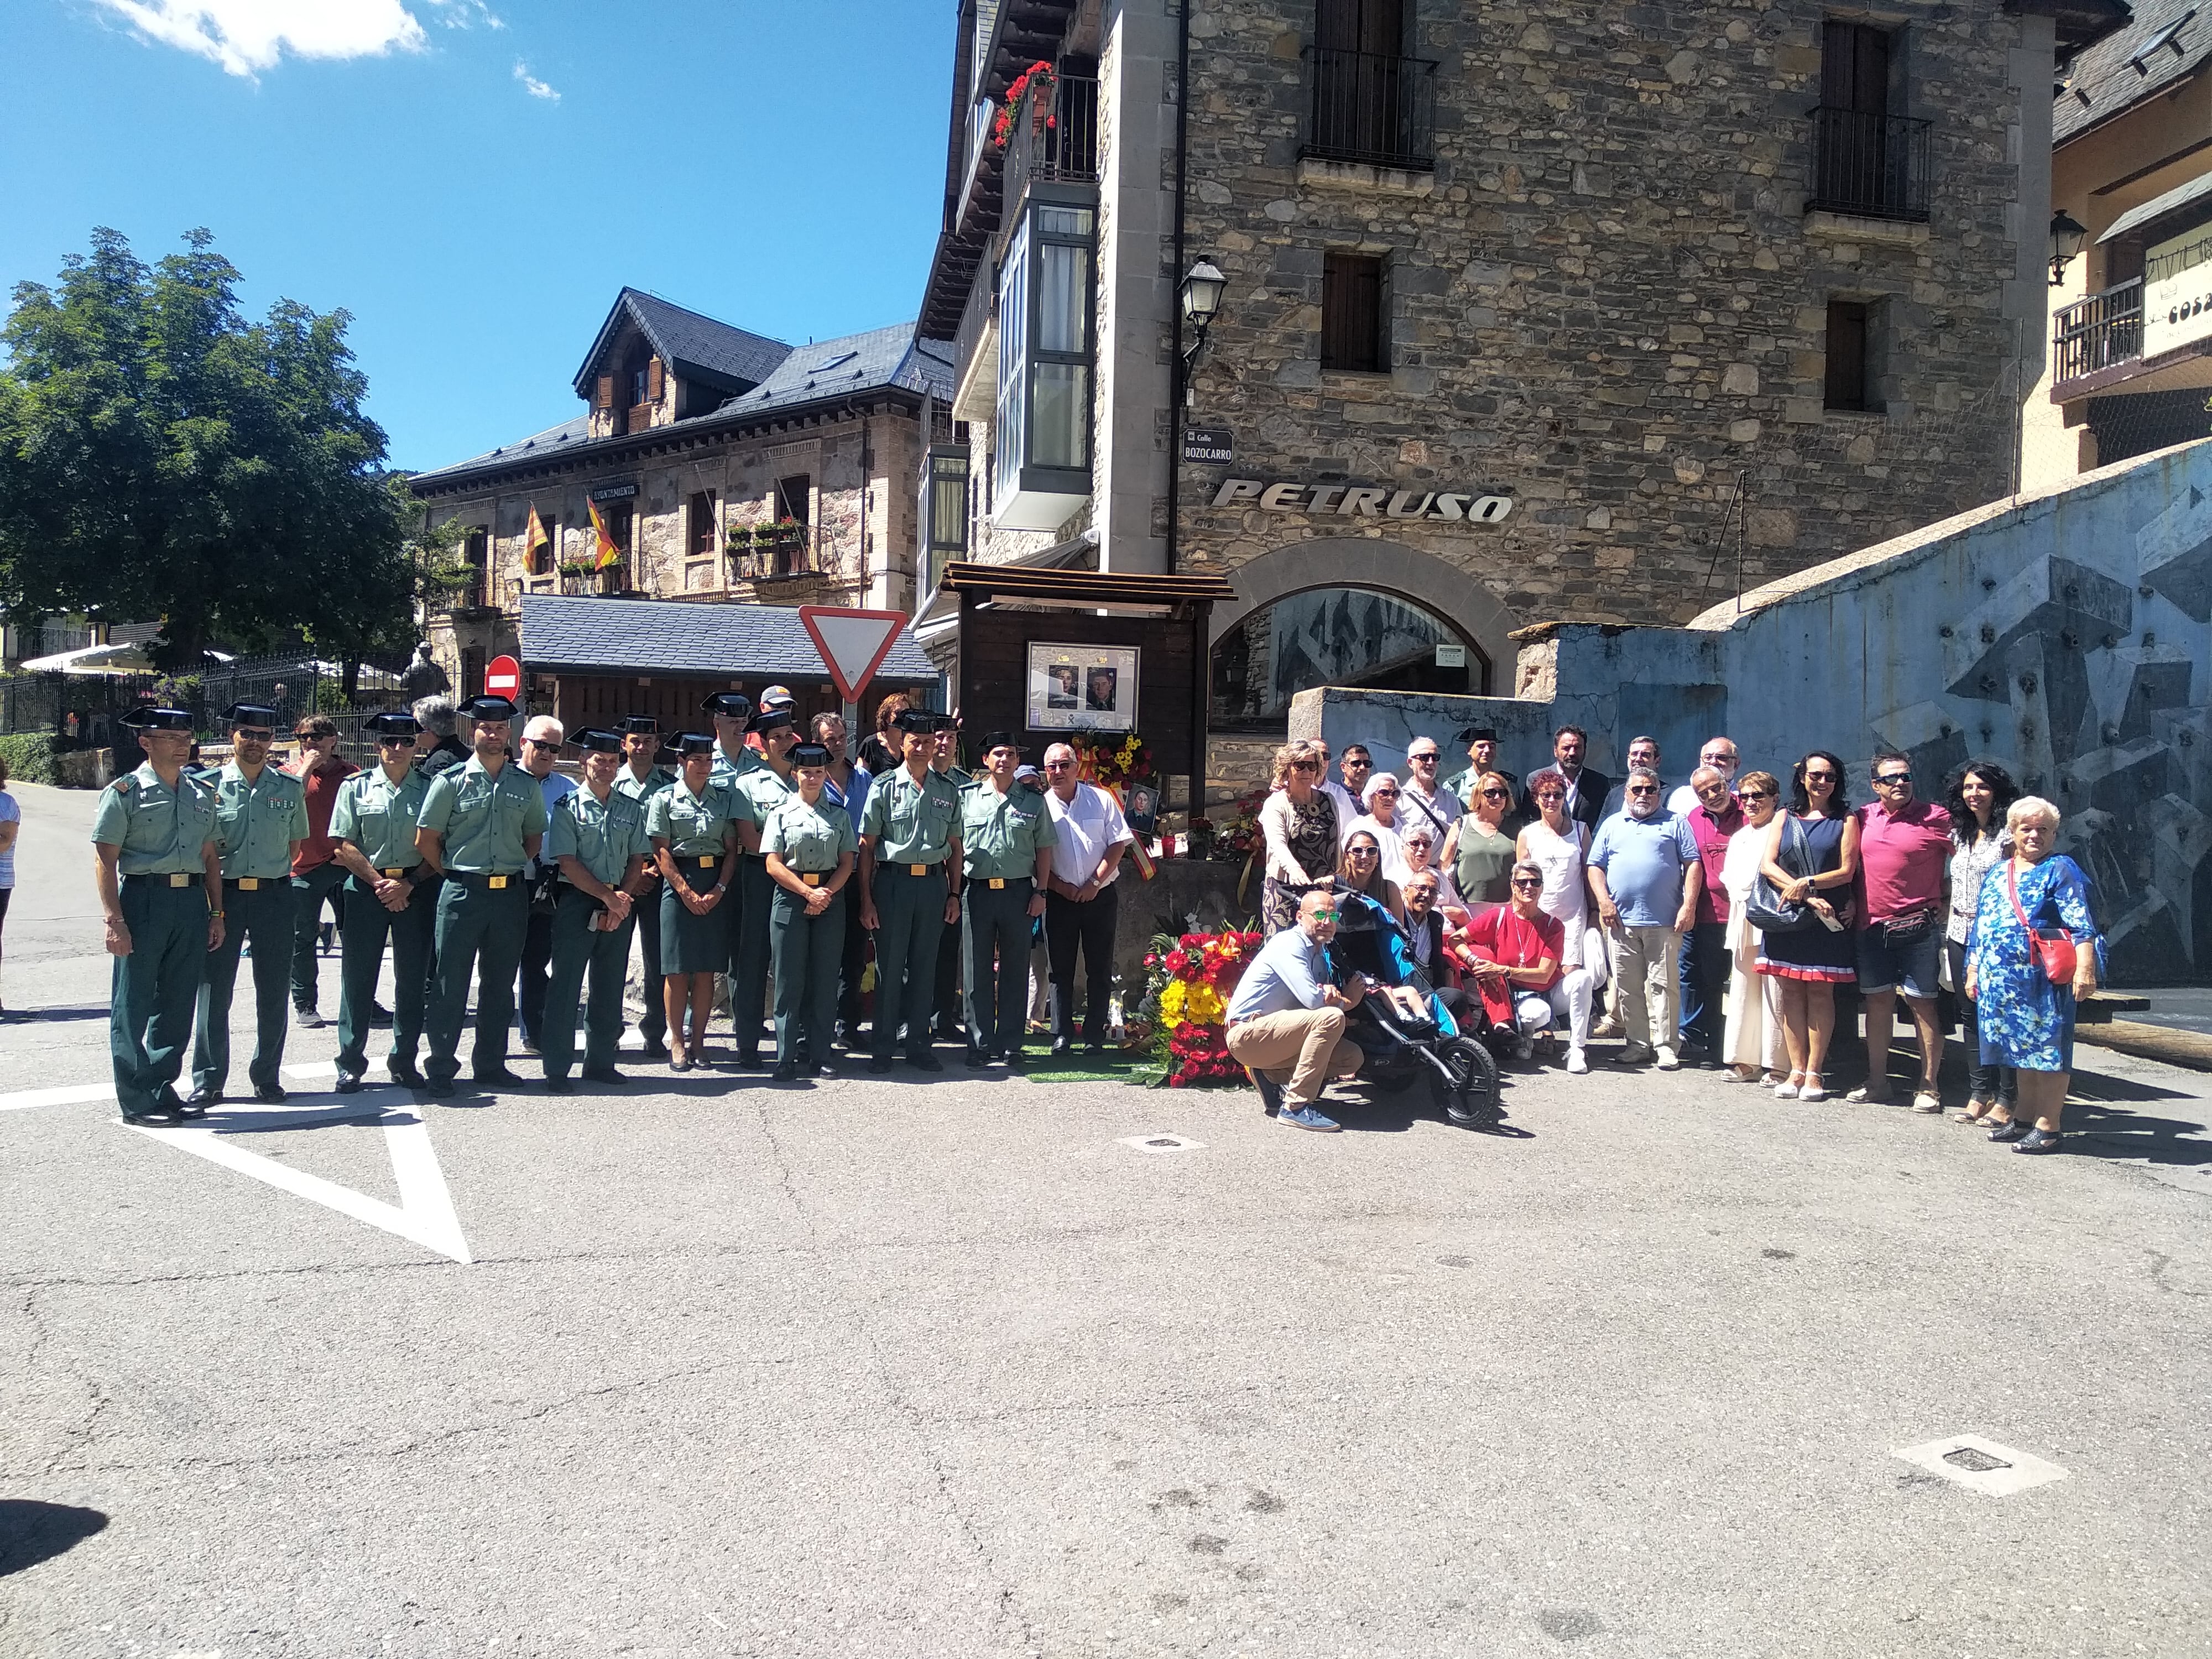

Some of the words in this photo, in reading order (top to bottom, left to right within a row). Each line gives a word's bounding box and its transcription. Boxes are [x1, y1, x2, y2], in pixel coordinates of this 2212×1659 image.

[1185, 447, 1232, 460] BOZOCARRO
[594, 486, 635, 500] AYUNTAMIENTO
[1211, 479, 1514, 523] PETRUSO
